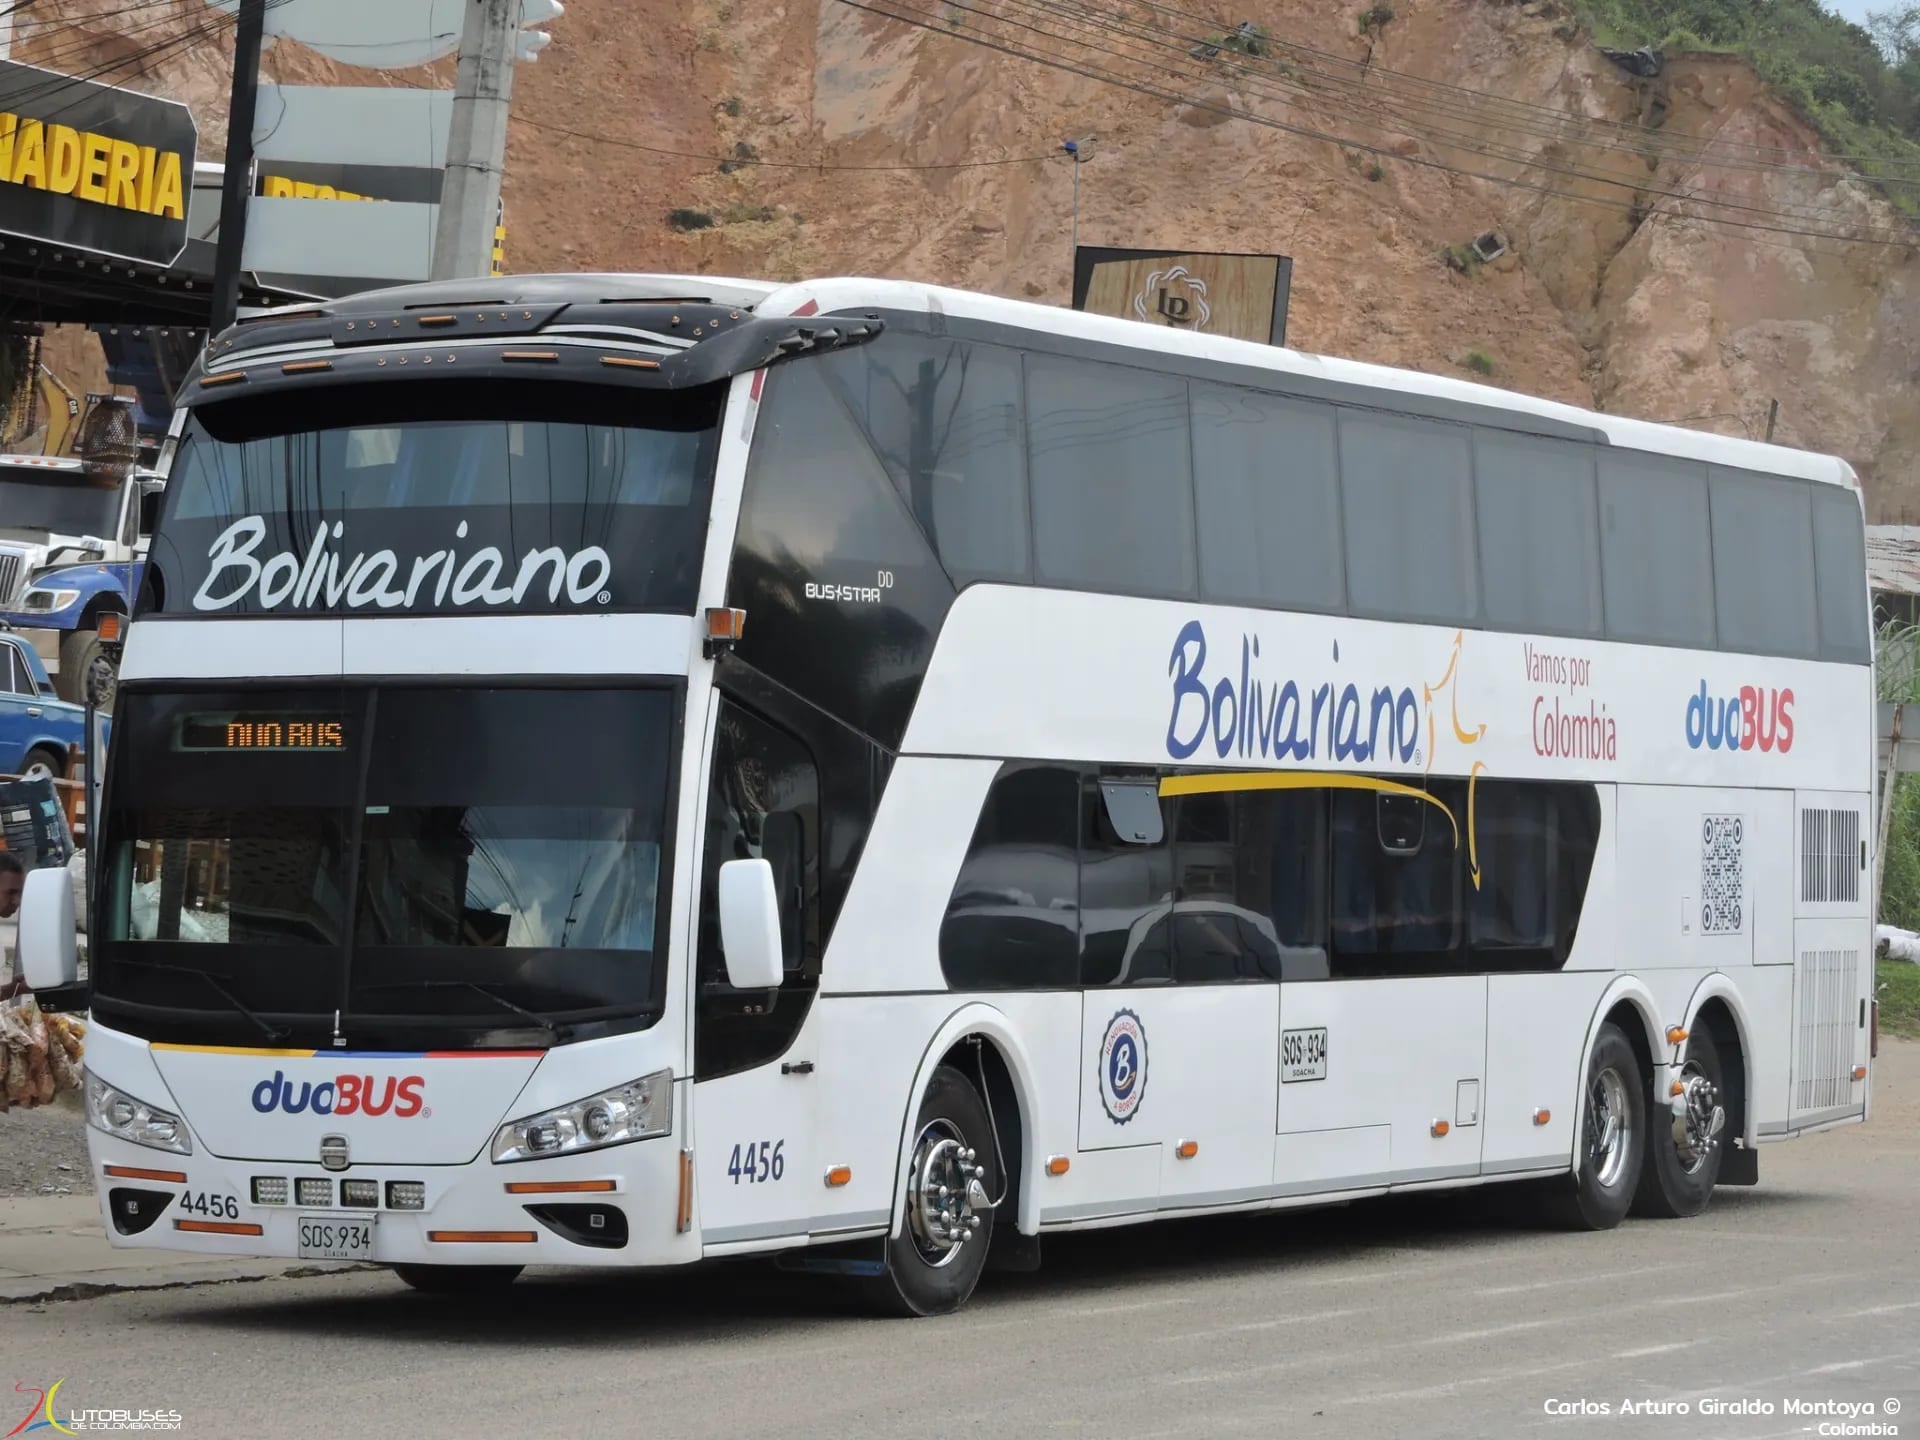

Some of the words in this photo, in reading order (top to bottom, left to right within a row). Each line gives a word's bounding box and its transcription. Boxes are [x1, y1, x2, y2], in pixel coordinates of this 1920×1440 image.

[1523, 642, 1567, 685] Vamos
[1570, 656, 1590, 695] por
[1532, 695, 1616, 761] Colombia
[1685, 679, 1794, 753] duoBUS
[1283, 1035, 1302, 1066] SOS
[1308, 1033, 1325, 1063] 934
[727, 1138, 785, 1185] 4456
[179, 1190, 239, 1219] 4456
[301, 1225, 333, 1248] SOS
[338, 1226, 371, 1249] 934
